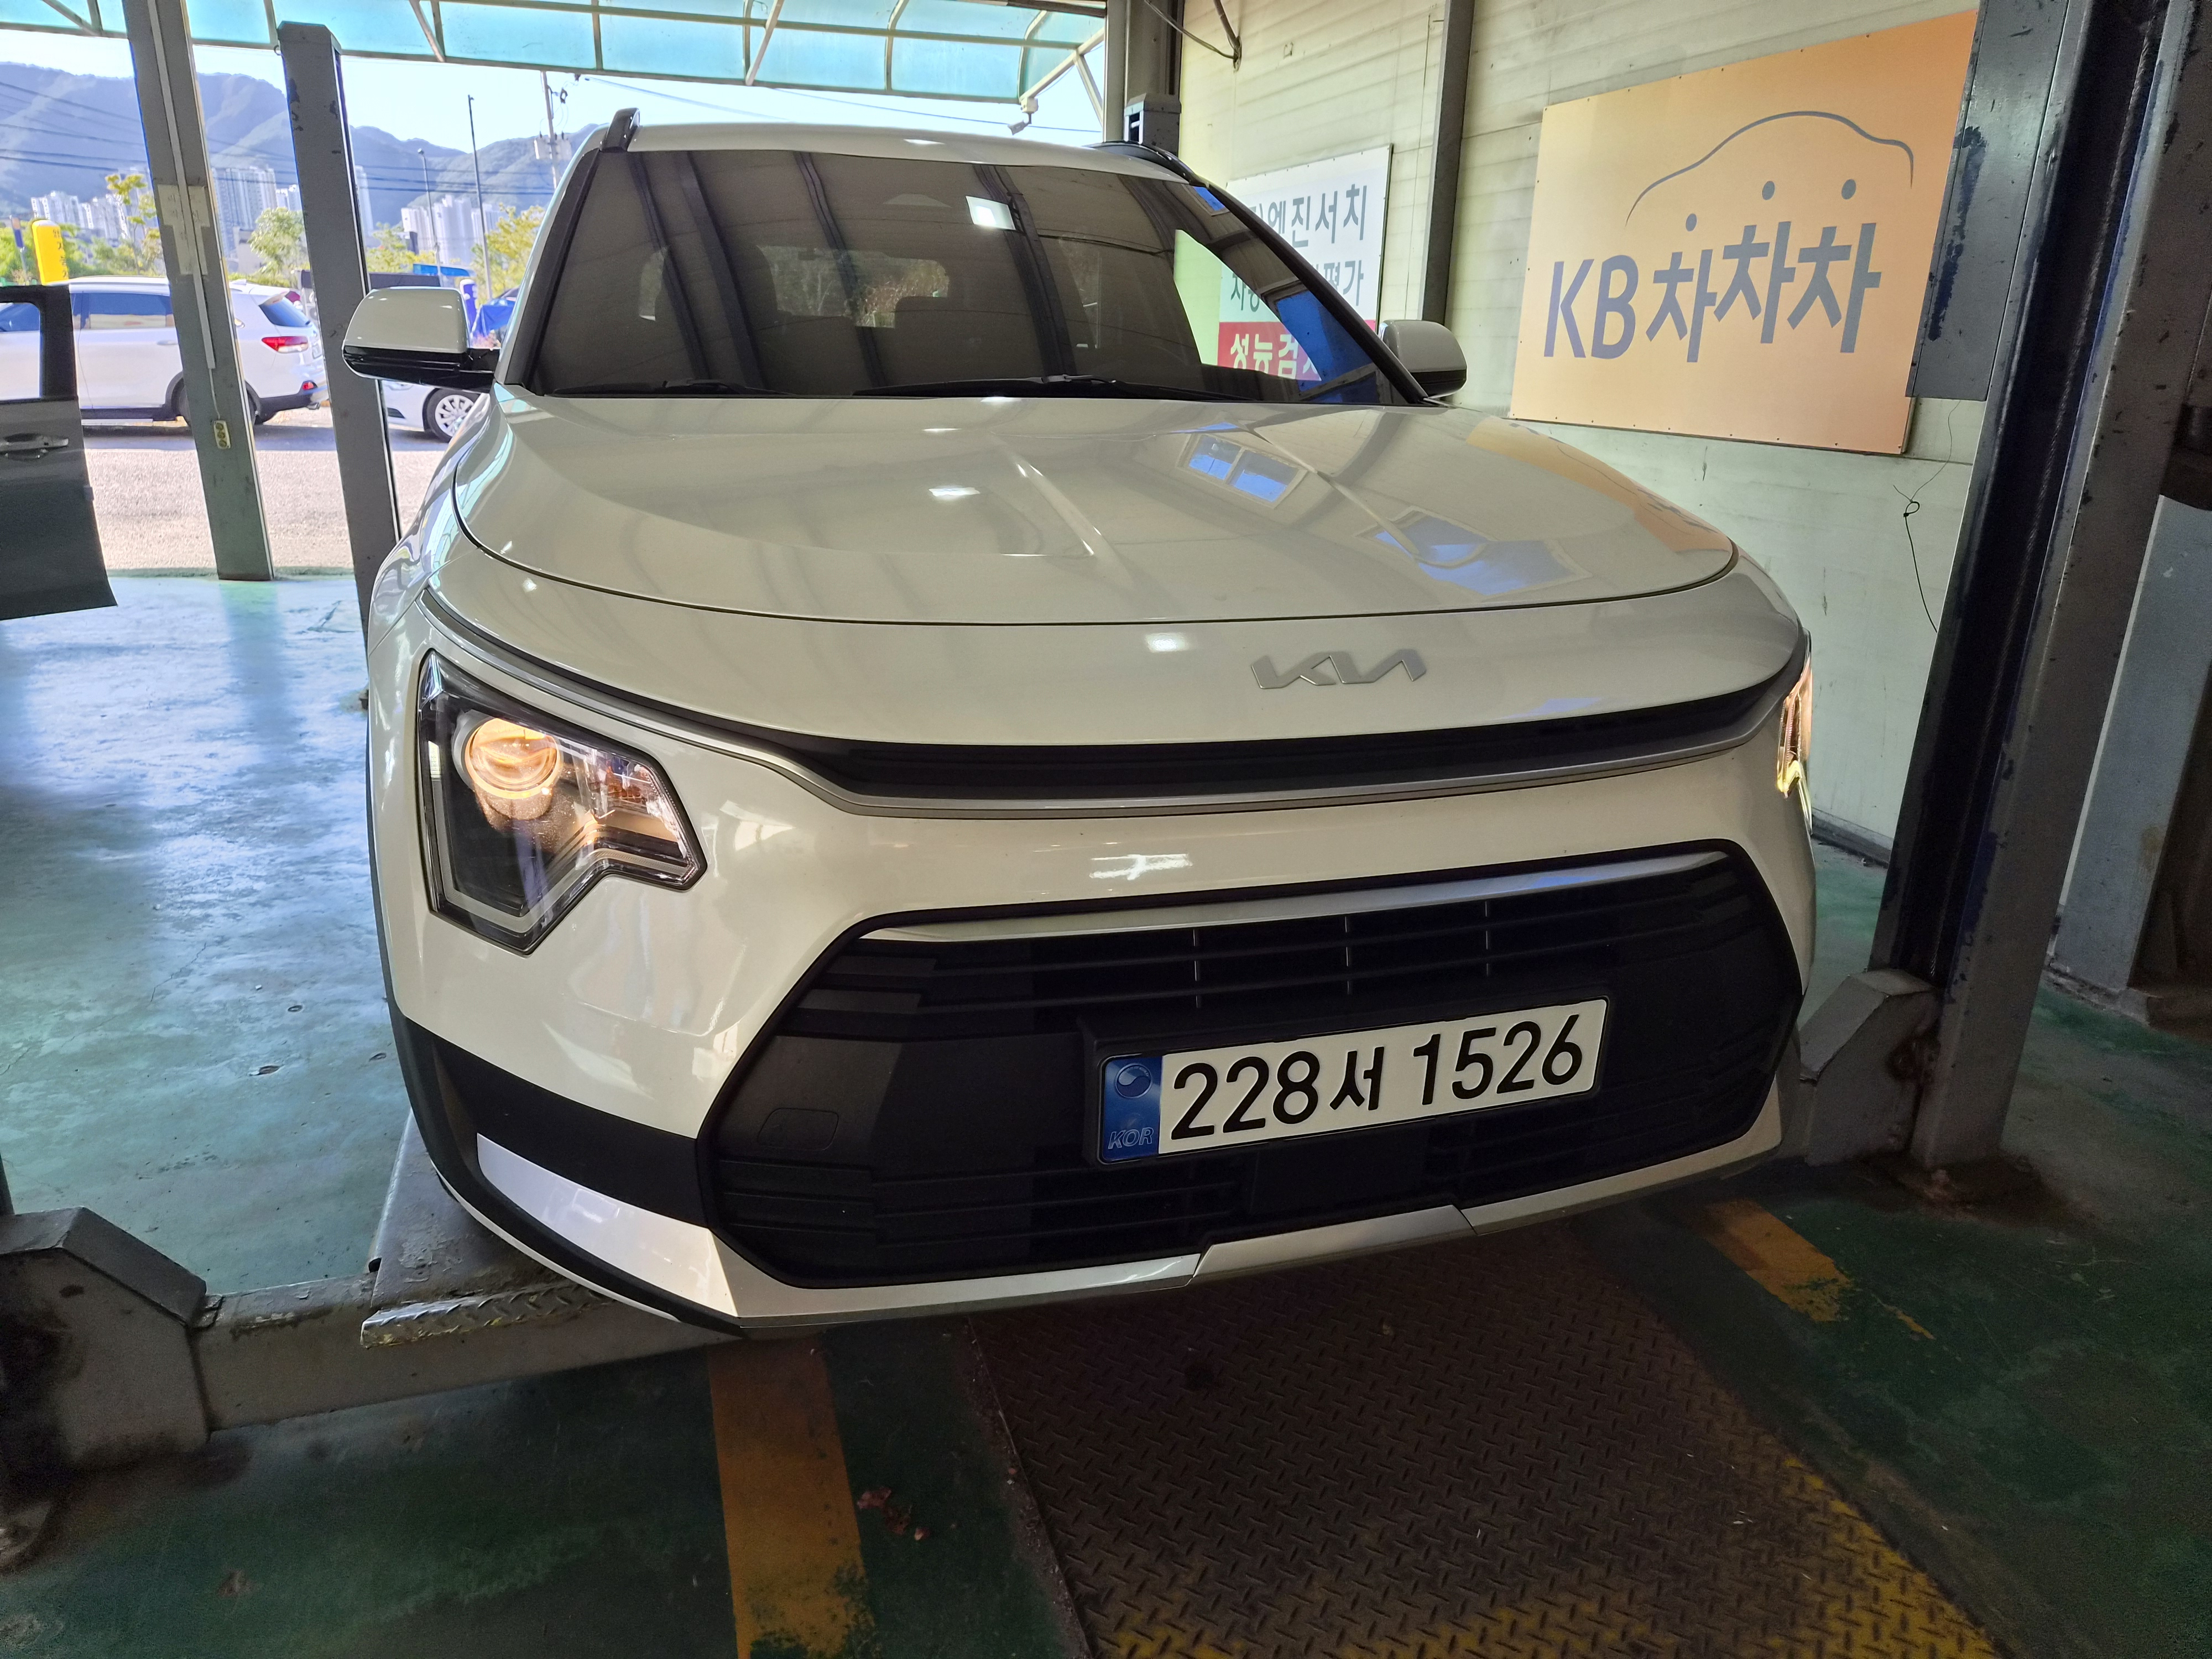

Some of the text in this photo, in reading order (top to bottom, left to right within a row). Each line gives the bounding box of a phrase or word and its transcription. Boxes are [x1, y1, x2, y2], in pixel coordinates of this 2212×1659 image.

[1250, 649, 1427, 689] KIA
[1170, 1014, 1583, 1140] 228서 1526
[1108, 1126, 1154, 1149] KOR
